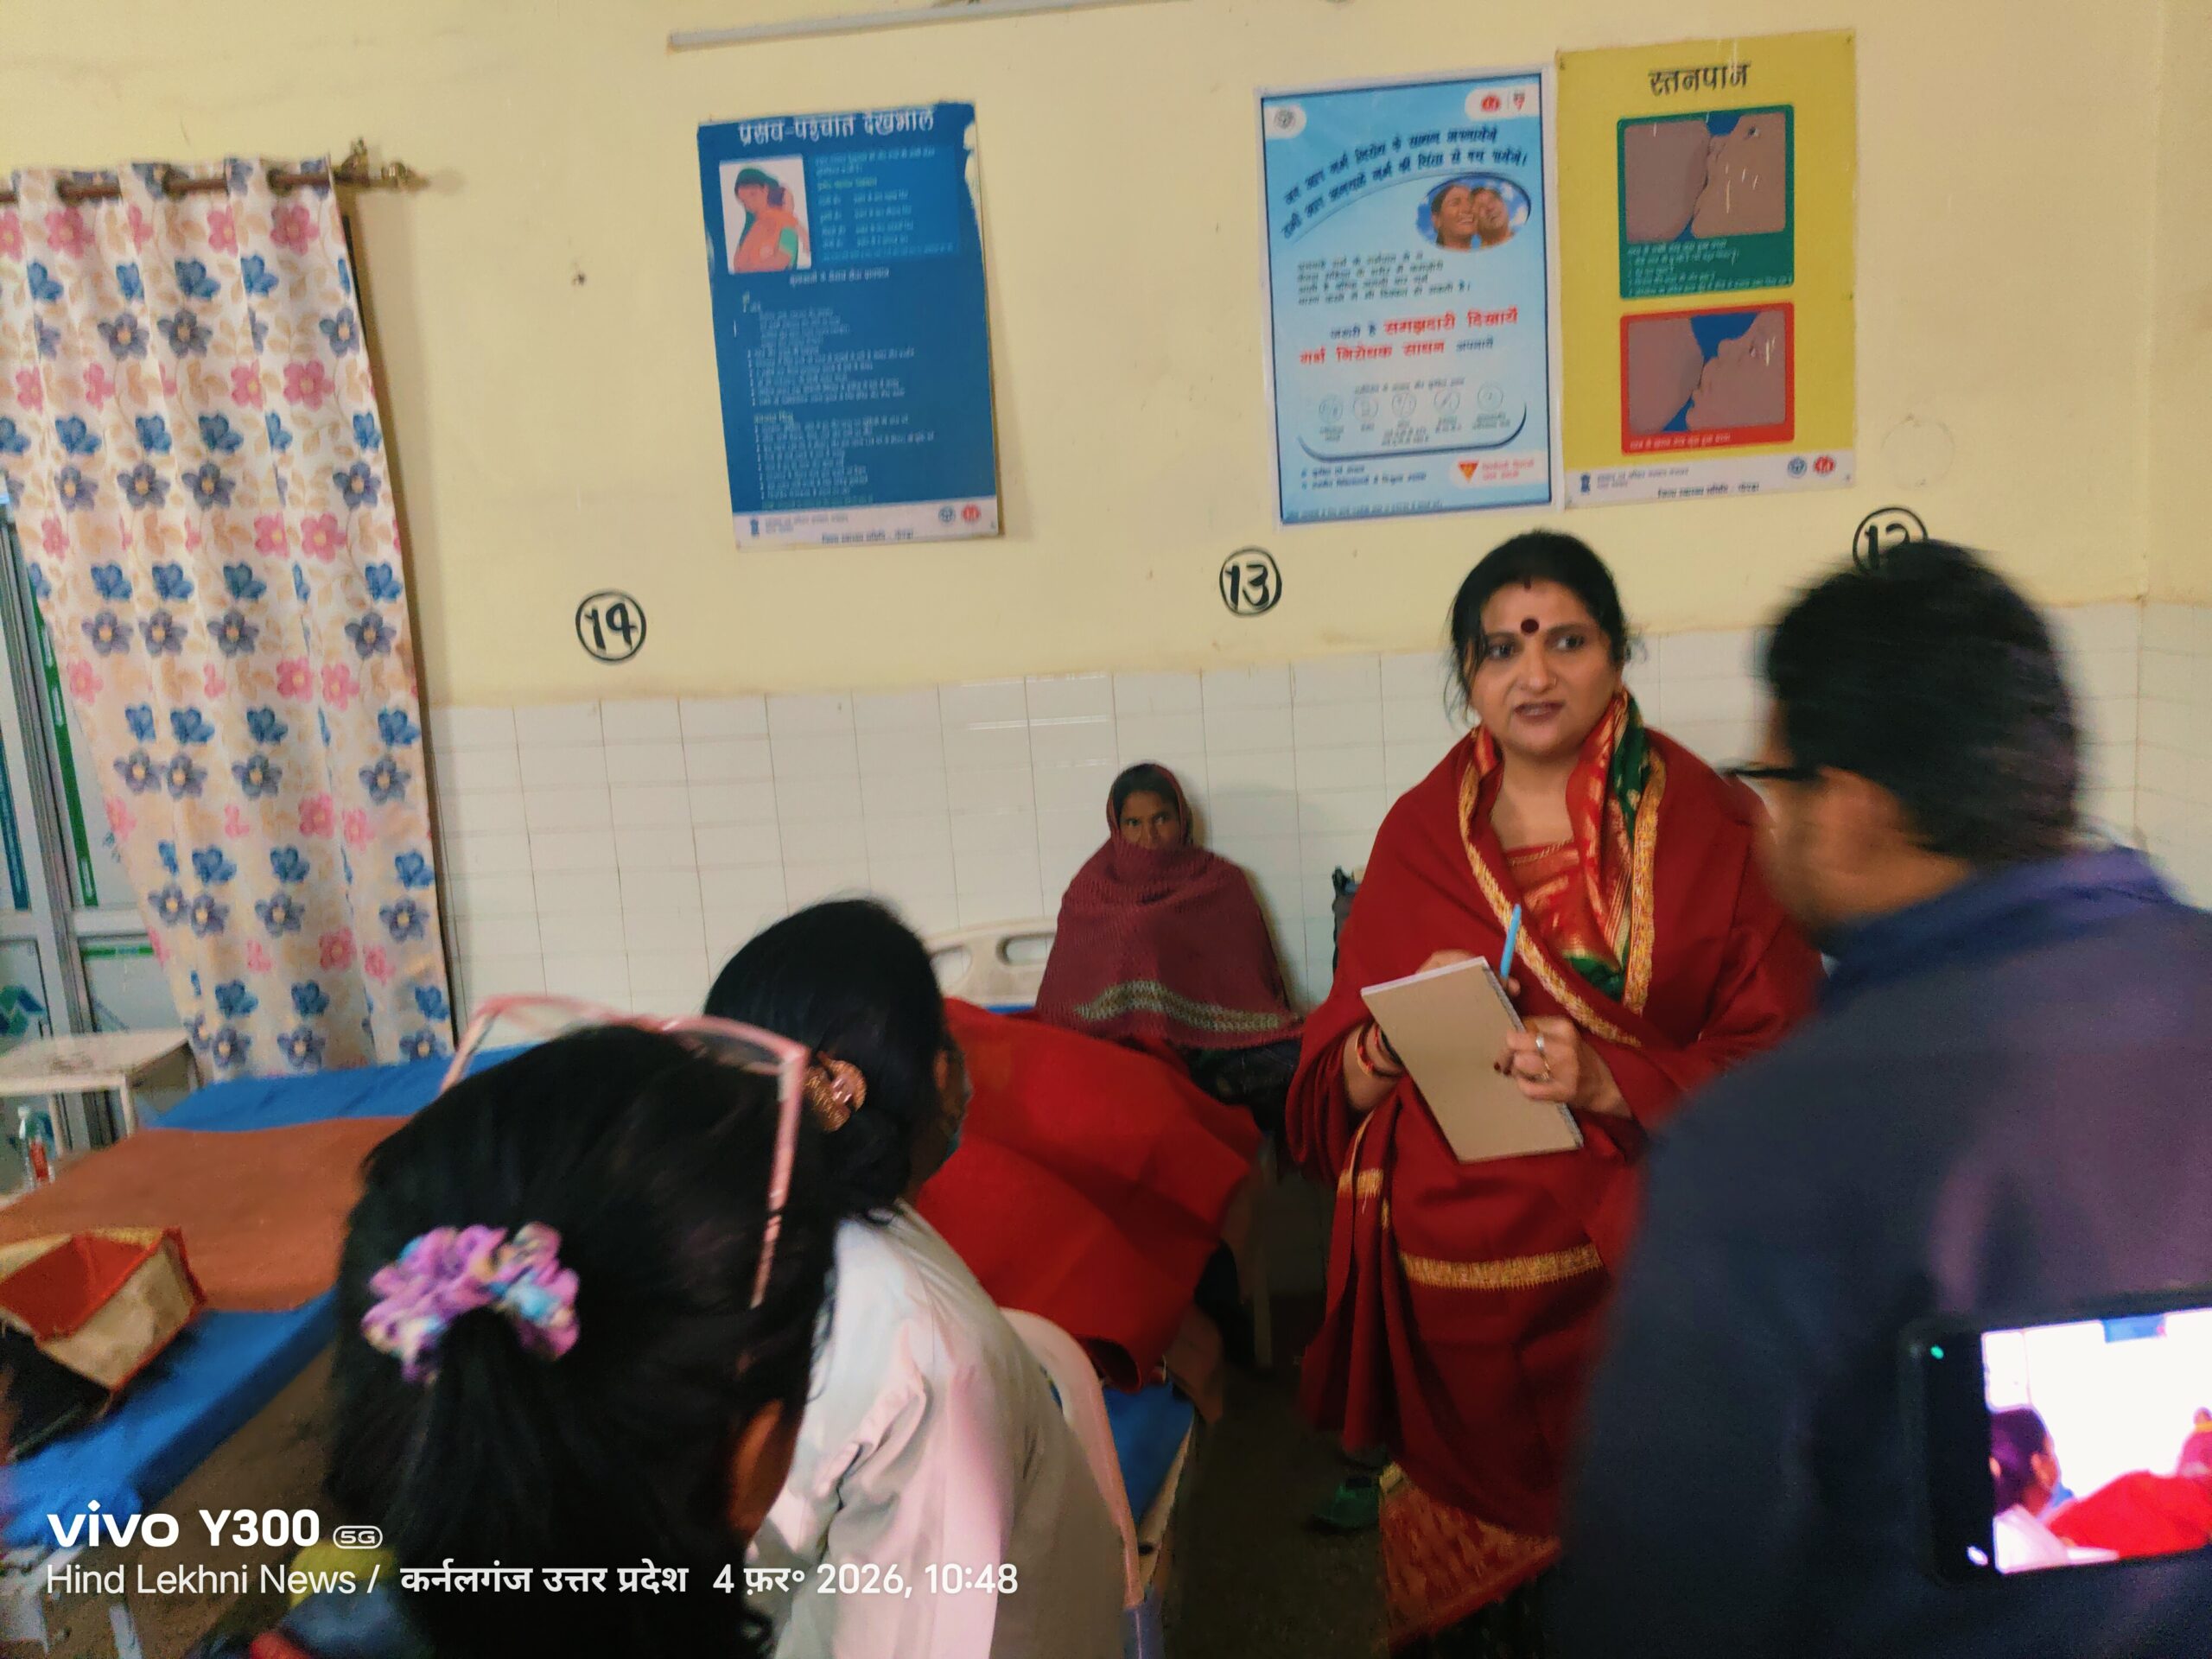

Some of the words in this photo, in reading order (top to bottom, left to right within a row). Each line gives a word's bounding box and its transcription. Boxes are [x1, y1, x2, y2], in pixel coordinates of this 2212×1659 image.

[1649, 60, 1751, 96] स्तनपान
[861, 105, 935, 137] देखभाल
[1368, 320, 1378, 336] है
[1383, 310, 1456, 336] समझदारी
[1300, 346, 1326, 365] गर्भ
[1336, 340, 1393, 363] निरोधक
[1402, 338, 1446, 358] साधन
[1224, 563, 1270, 611] 13
